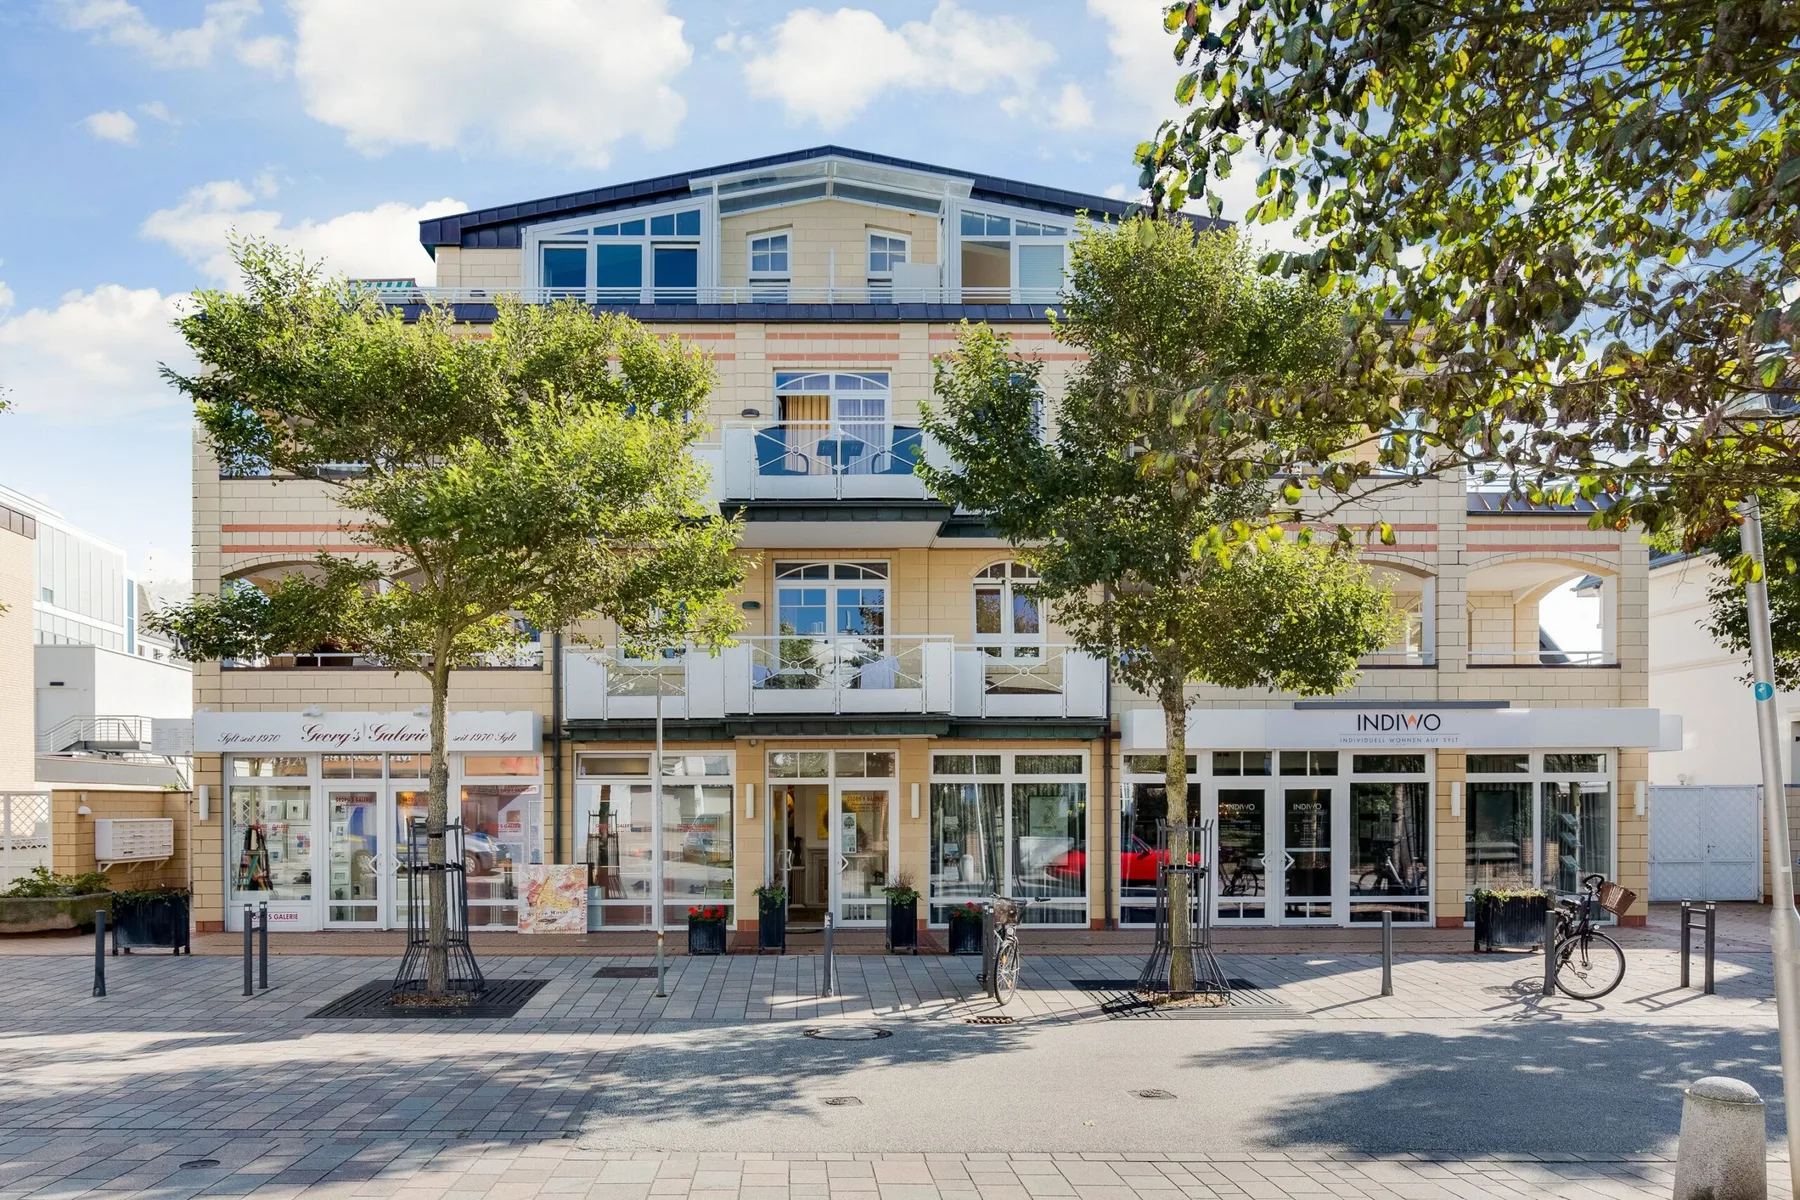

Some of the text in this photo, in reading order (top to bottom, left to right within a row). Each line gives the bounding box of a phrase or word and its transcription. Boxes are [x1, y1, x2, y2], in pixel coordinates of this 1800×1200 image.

[1357, 713, 1441, 732] INDIWO
[218, 732, 281, 746] Sylt seit 1970
[301, 723, 429, 748] Georg's Galerie
[452, 731, 518, 744] seit 1970 Sylt
